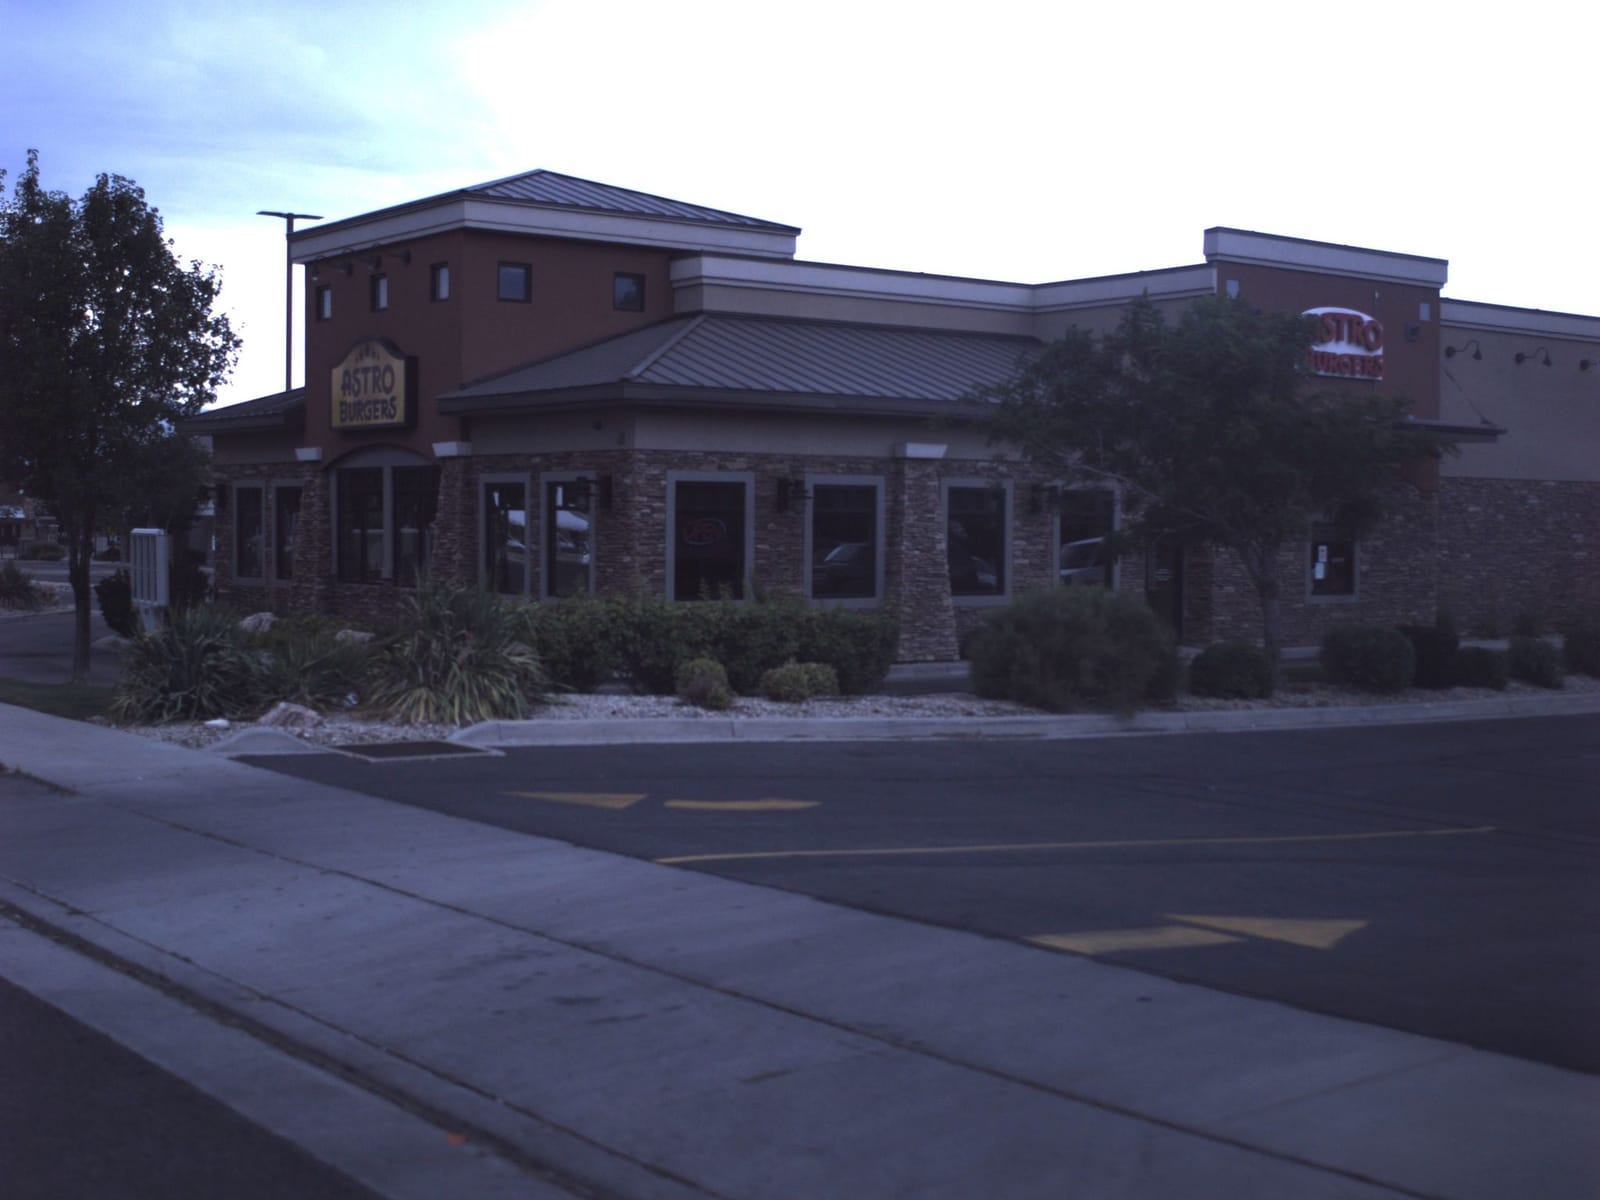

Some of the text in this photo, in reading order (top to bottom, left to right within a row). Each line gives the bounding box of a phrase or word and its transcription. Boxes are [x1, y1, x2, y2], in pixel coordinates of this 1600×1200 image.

[1308, 312, 1384, 352] STRO
[341, 363, 395, 397] ASTRO
[340, 396, 397, 422] BURGERS
